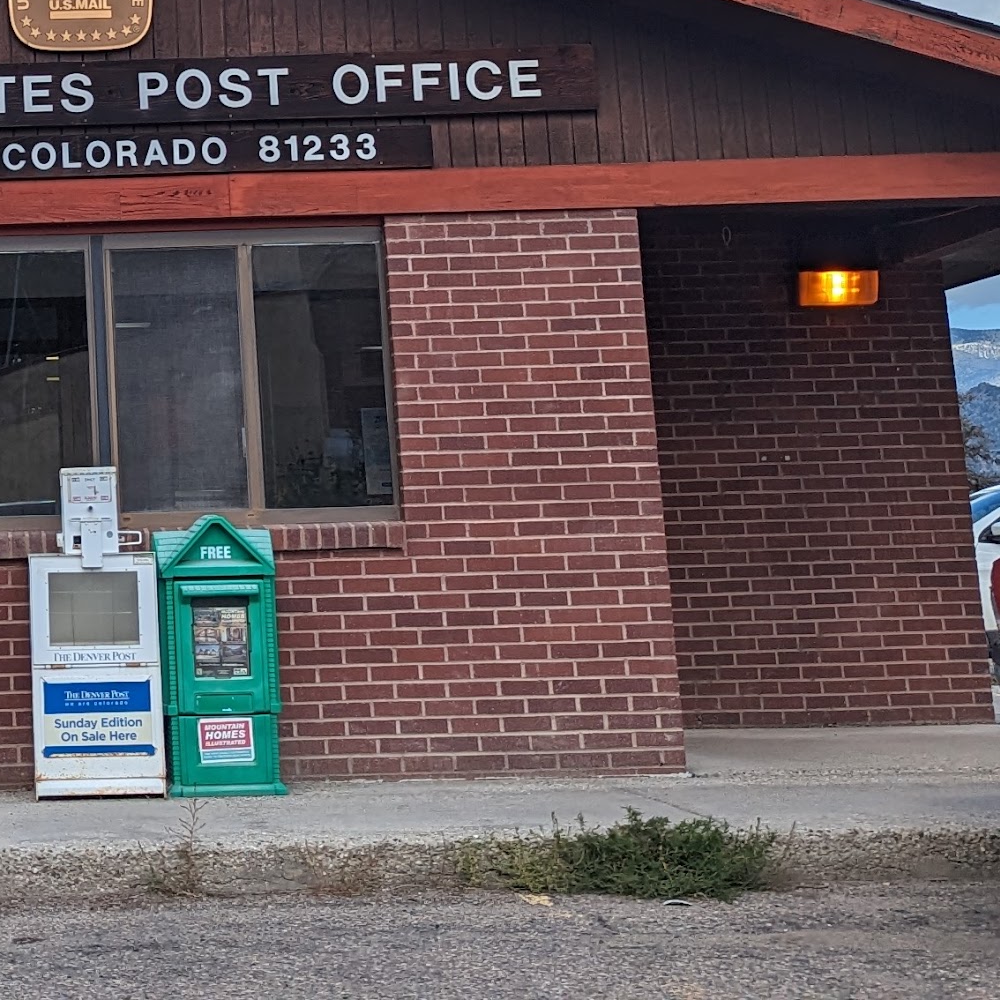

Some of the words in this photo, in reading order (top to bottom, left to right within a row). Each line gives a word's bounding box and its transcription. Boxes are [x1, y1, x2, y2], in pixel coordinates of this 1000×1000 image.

[48, 0, 112, 10] U.S.MAIL
[138, 67, 290, 110] POST
[332, 59, 543, 105] OFFICE
[2, 136, 228, 171] COLORADO
[258, 133, 378, 163] 81233
[200, 545, 232, 560] FREE
[54, 653, 72, 662] THE
[73, 652, 111, 661] DENVER
[112, 651, 137, 660] POST
[64, 690, 80, 699] THE
[81, 690, 111, 699] DENVER
[111, 689, 130, 699] POST
[54, 718, 98, 730] Sunday
[101, 717, 143, 728] Edition
[204, 722, 246, 731] MOUNTAIN
[61, 732, 79, 742] On
[81, 731, 107, 742] Sale
[109, 731, 138, 741] Here
[205, 729, 247, 740] HOMES
[205, 739, 247, 747] ILLUSTRATED
